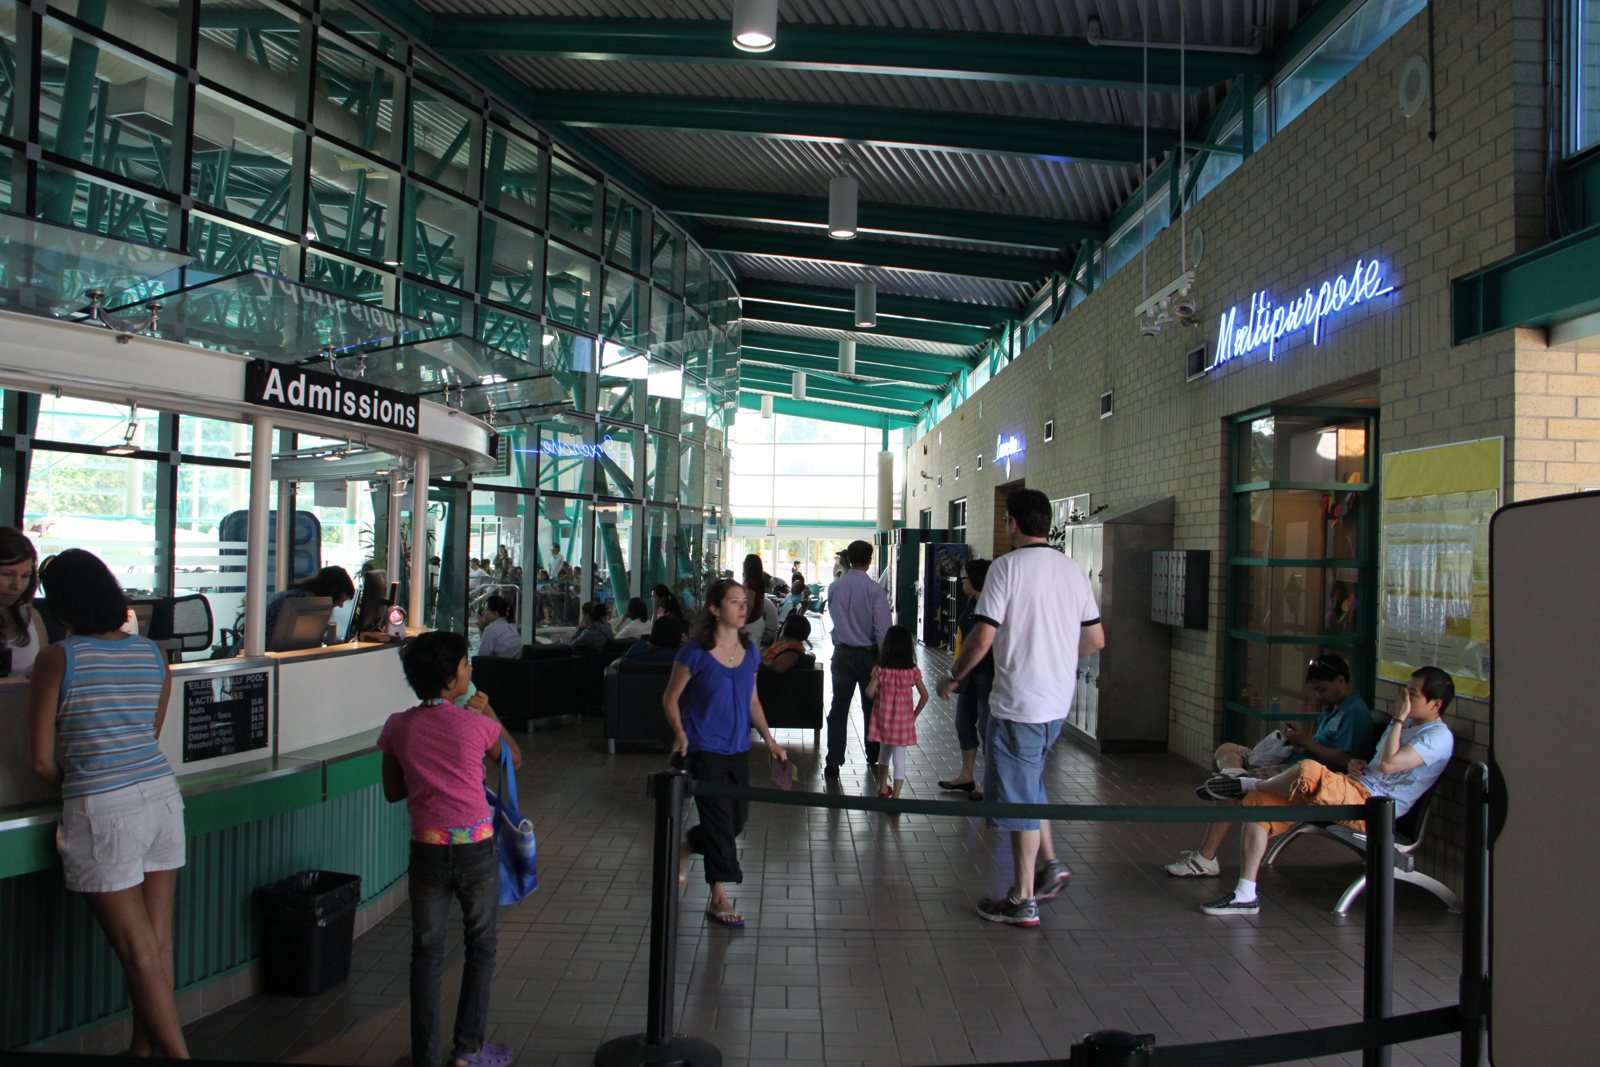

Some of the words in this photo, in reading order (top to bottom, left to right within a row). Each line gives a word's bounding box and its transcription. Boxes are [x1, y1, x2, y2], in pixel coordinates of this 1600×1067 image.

[1209, 259, 1389, 367] Multipurpose
[262, 367, 416, 428] Admissions
[189, 681, 213, 690] EILEE
[246, 674, 265, 683] POOL
[189, 715, 211, 723] Students
[189, 725, 208, 733] Seniors
[189, 733, 209, 741] Children
[251, 721, 264, 730] $2.77
[189, 740, 213, 750] Preschool
